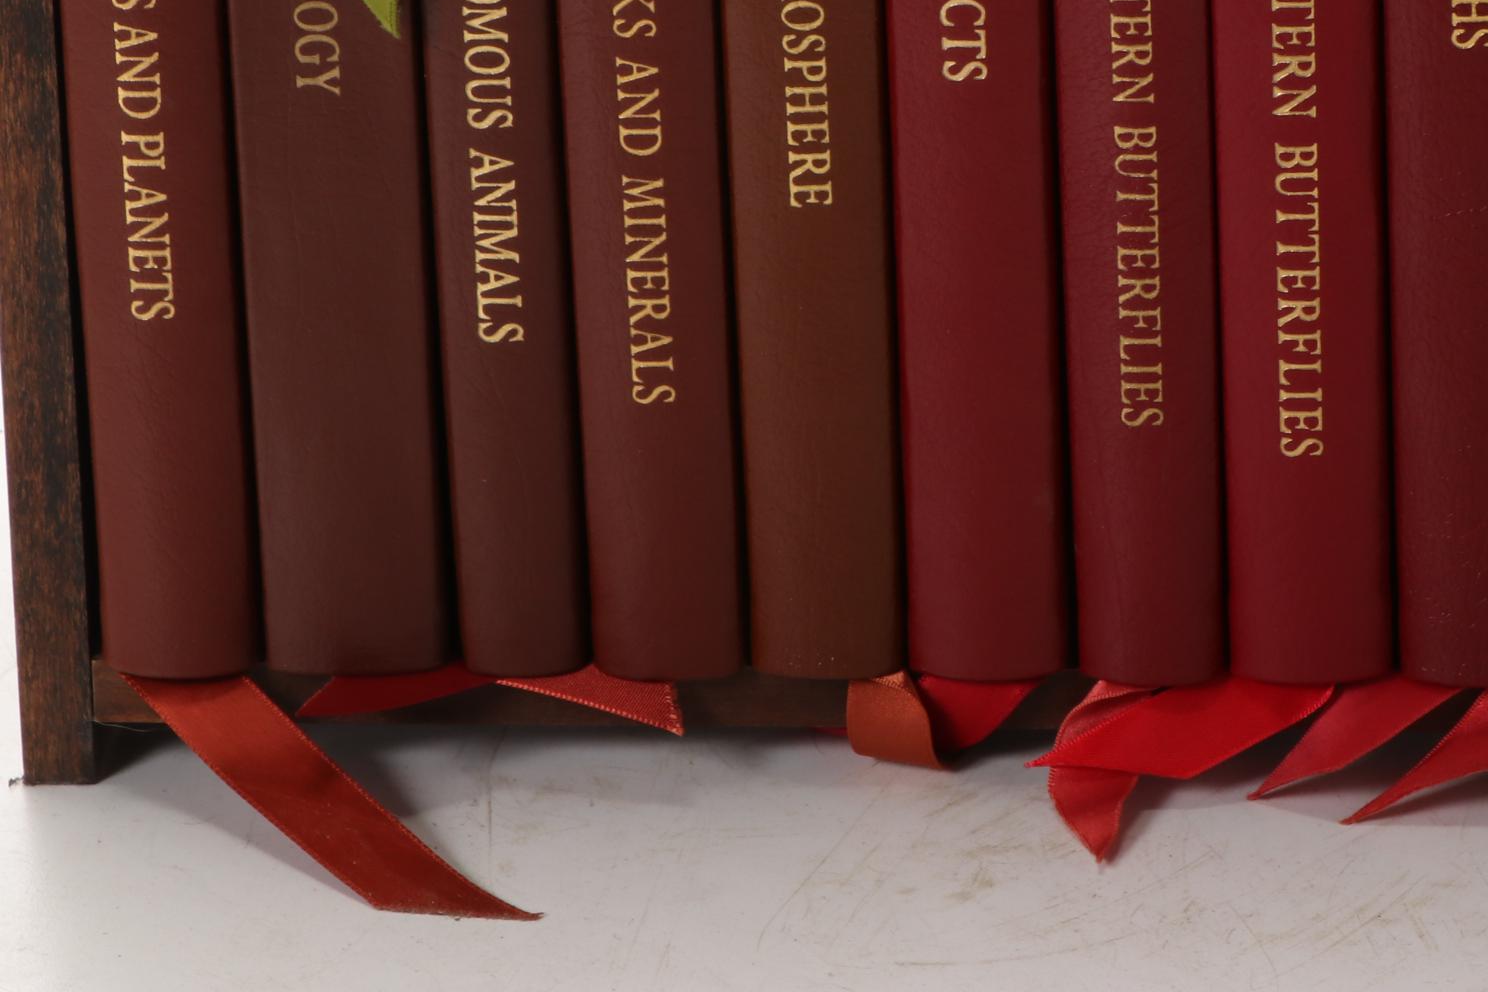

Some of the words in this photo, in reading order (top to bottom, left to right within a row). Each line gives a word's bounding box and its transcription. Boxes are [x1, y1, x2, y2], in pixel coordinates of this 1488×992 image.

[113, 21, 162, 120] AND
[615, 56, 662, 157] AND
[120, 130, 176, 321] PLANETS
[468, 147, 524, 344] ANIMALS
[621, 174, 676, 405] MINERALS
[1113, 125, 1164, 427] BUTTERFLIES
[1274, 142, 1324, 458] BUTTERFLIES
